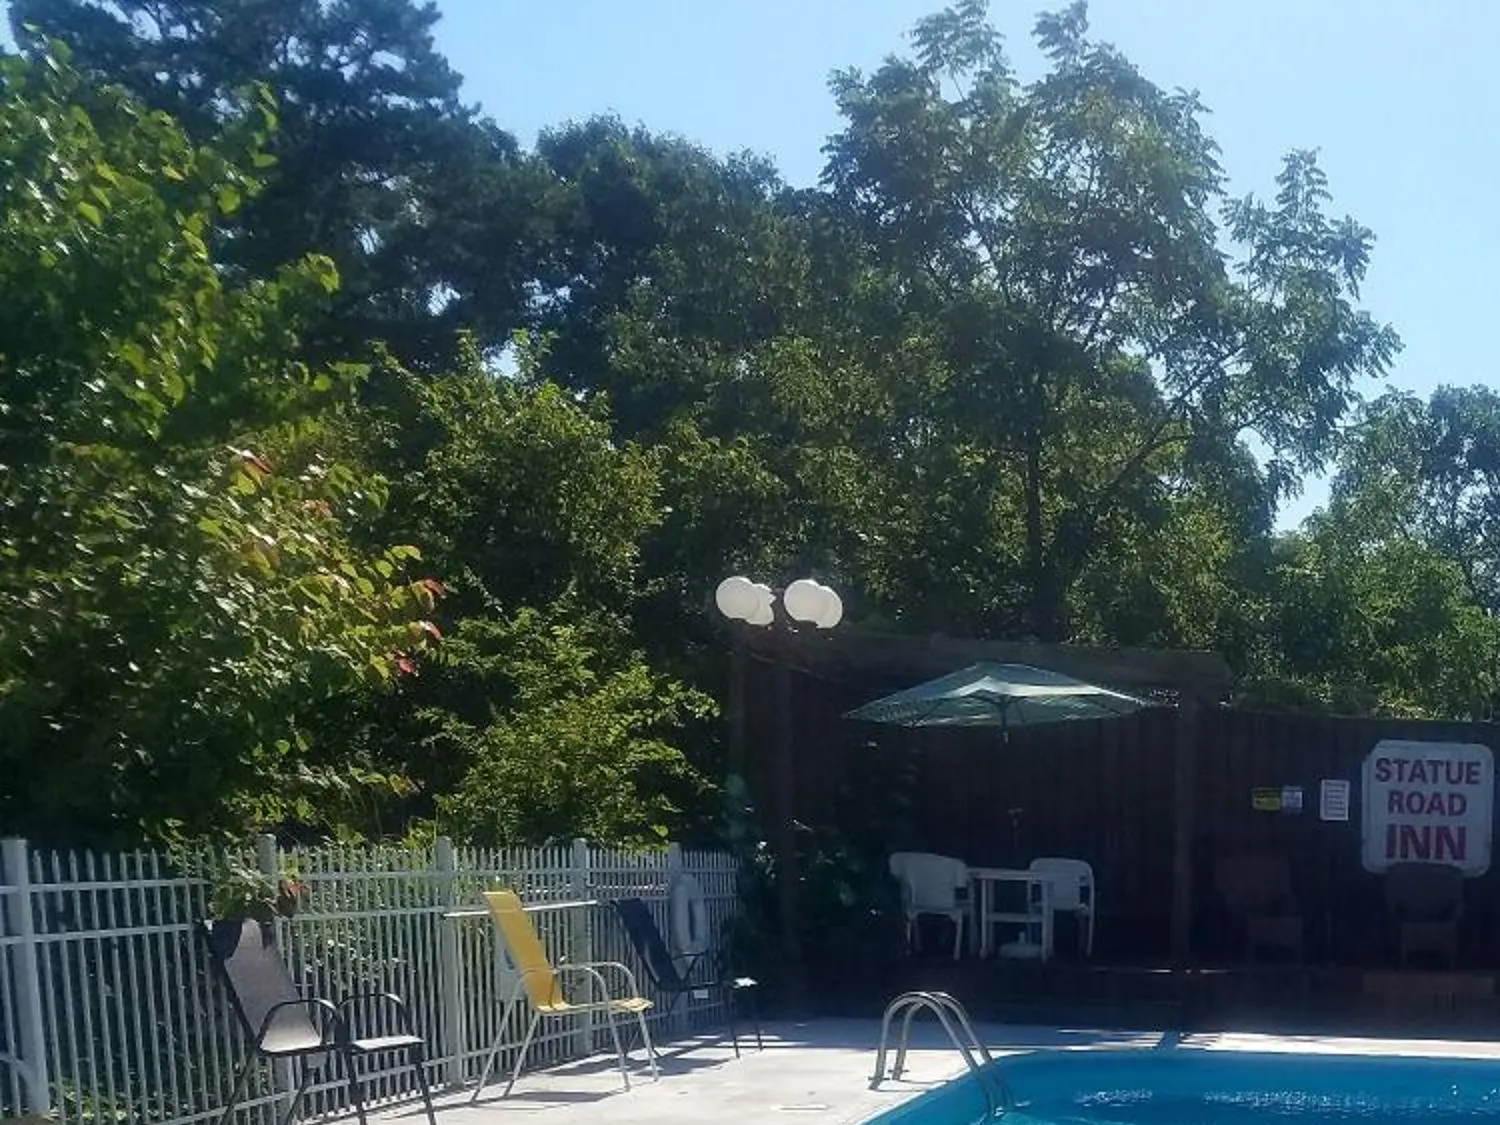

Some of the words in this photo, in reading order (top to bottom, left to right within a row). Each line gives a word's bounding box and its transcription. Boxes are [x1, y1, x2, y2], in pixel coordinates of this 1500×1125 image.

[1375, 757, 1481, 785] STATUE
[1388, 790, 1467, 817] ROAD
[1386, 824, 1466, 860] INN
